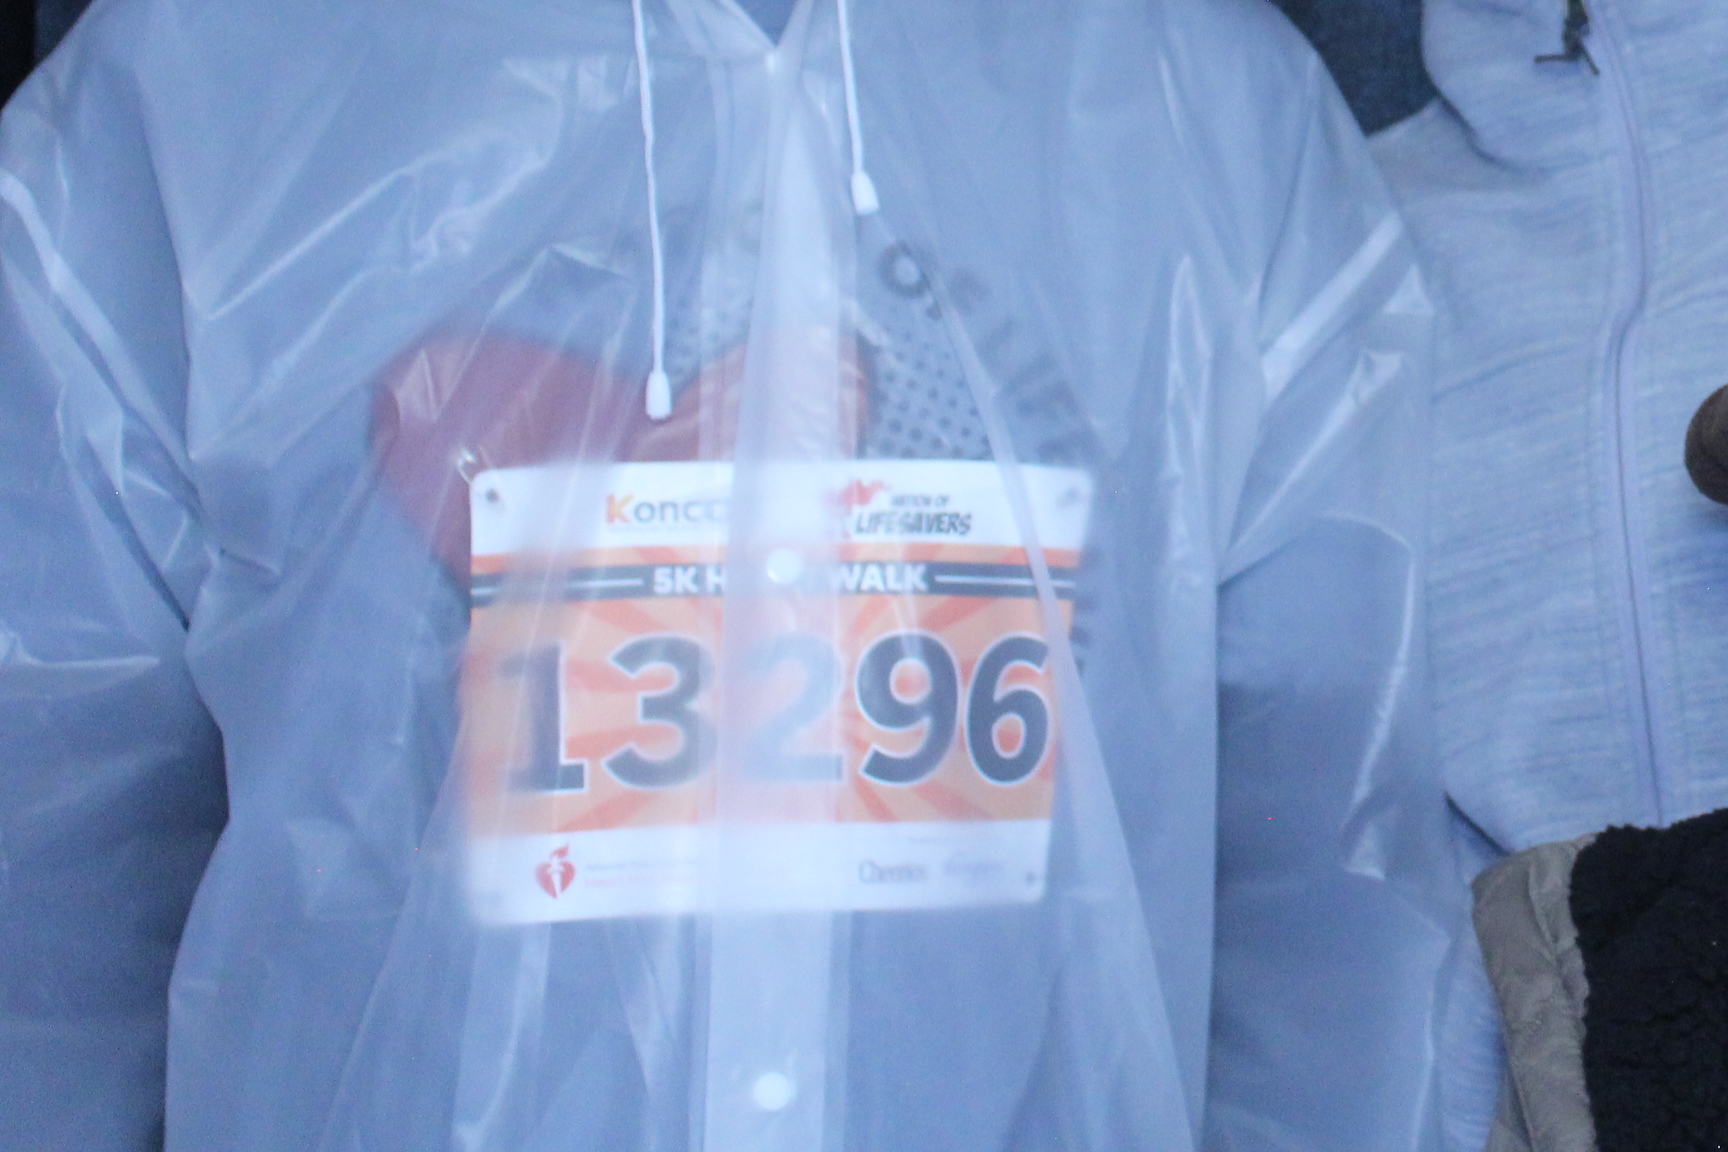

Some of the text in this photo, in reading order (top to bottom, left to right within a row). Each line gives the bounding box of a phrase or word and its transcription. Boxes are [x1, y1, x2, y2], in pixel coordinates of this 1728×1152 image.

[653, 565, 699, 595] 5K
[830, 562, 928, 593] WALK
[498, 632, 1050, 794] 13296
